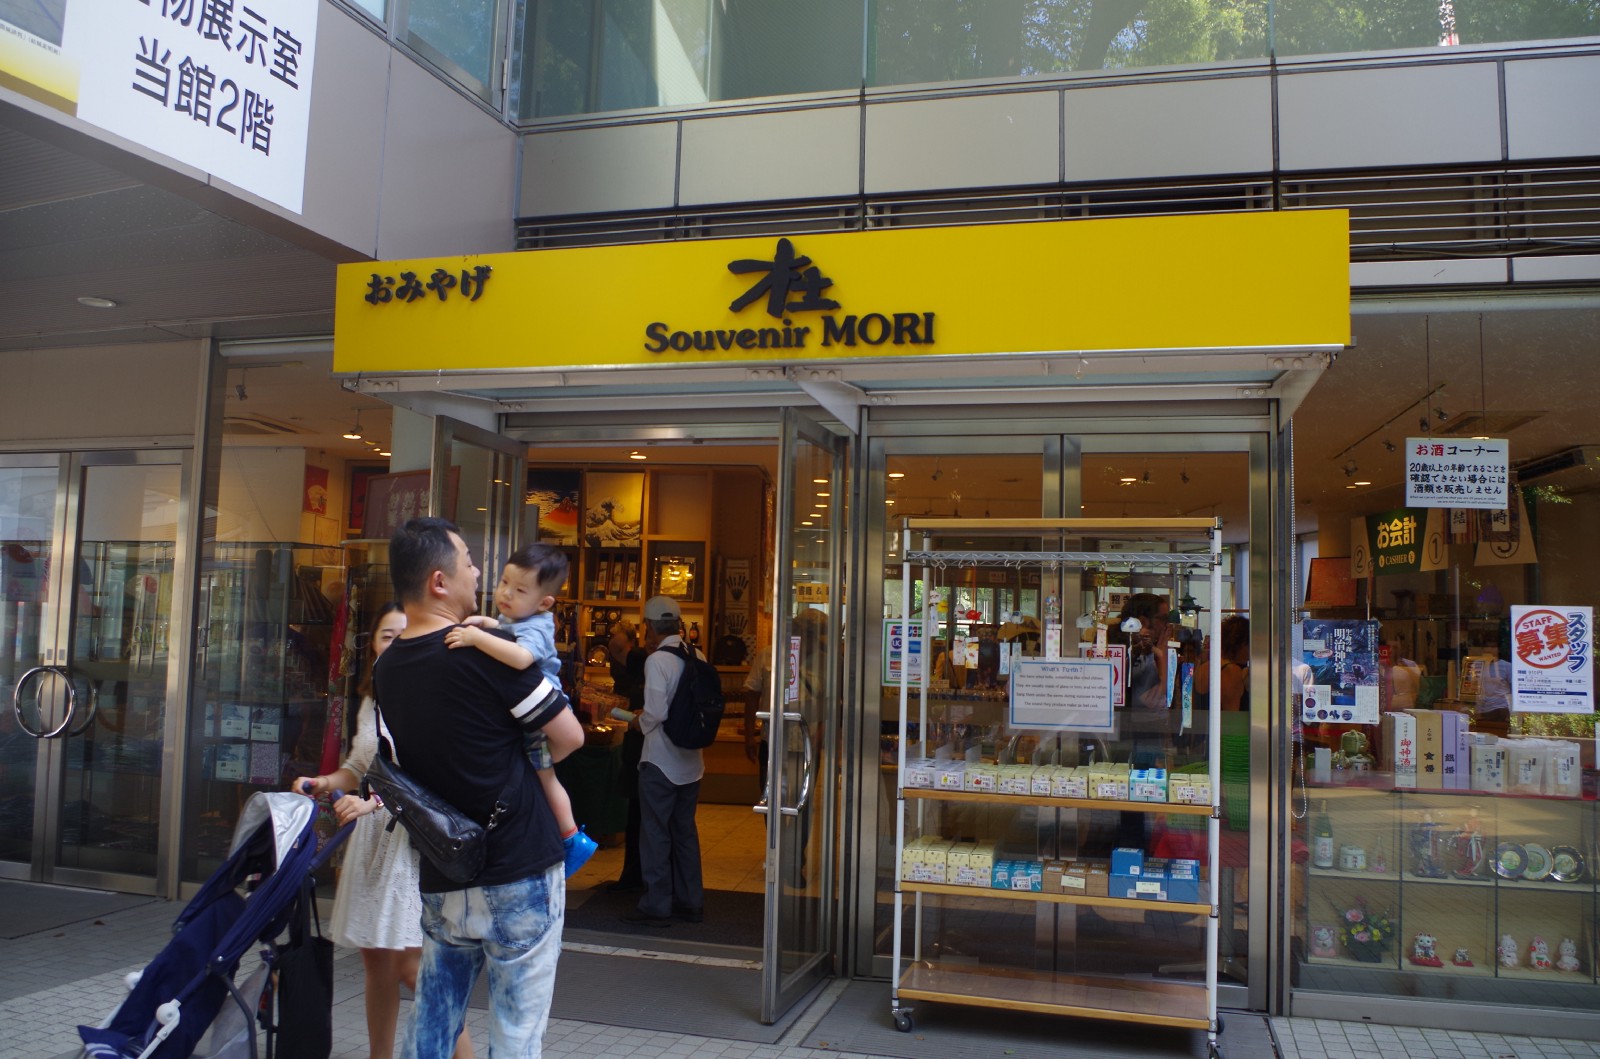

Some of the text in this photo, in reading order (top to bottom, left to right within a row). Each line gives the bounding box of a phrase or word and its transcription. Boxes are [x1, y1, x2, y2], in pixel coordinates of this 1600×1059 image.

[132, 35, 276, 157] 当館2階
[364, 264, 492, 306] おみやげ
[727, 237, 841, 318] 杜
[644, 312, 935, 353] Souvenir MORI
[1409, 462, 1506, 473] 20歳以上の年齢であることを
[1409, 474, 1506, 484] 確認できない場合には
[1413, 483, 1502, 495] 酒類を販売しません
[1376, 515, 1418, 550] お会計
[1355, 550, 1364, 569] 2
[1385, 554, 1408, 565] CASHIER
[1522, 615, 1552, 630] STAFF
[1333, 628, 1346, 673] 明治神宮
[1516, 623, 1569, 658] 募集
[1567, 612, 1587, 672] スタッフ
[1538, 652, 1562, 662] WANTED
[1040, 665, 1059, 673] What's
[1424, 751, 1435, 773] 金婚
